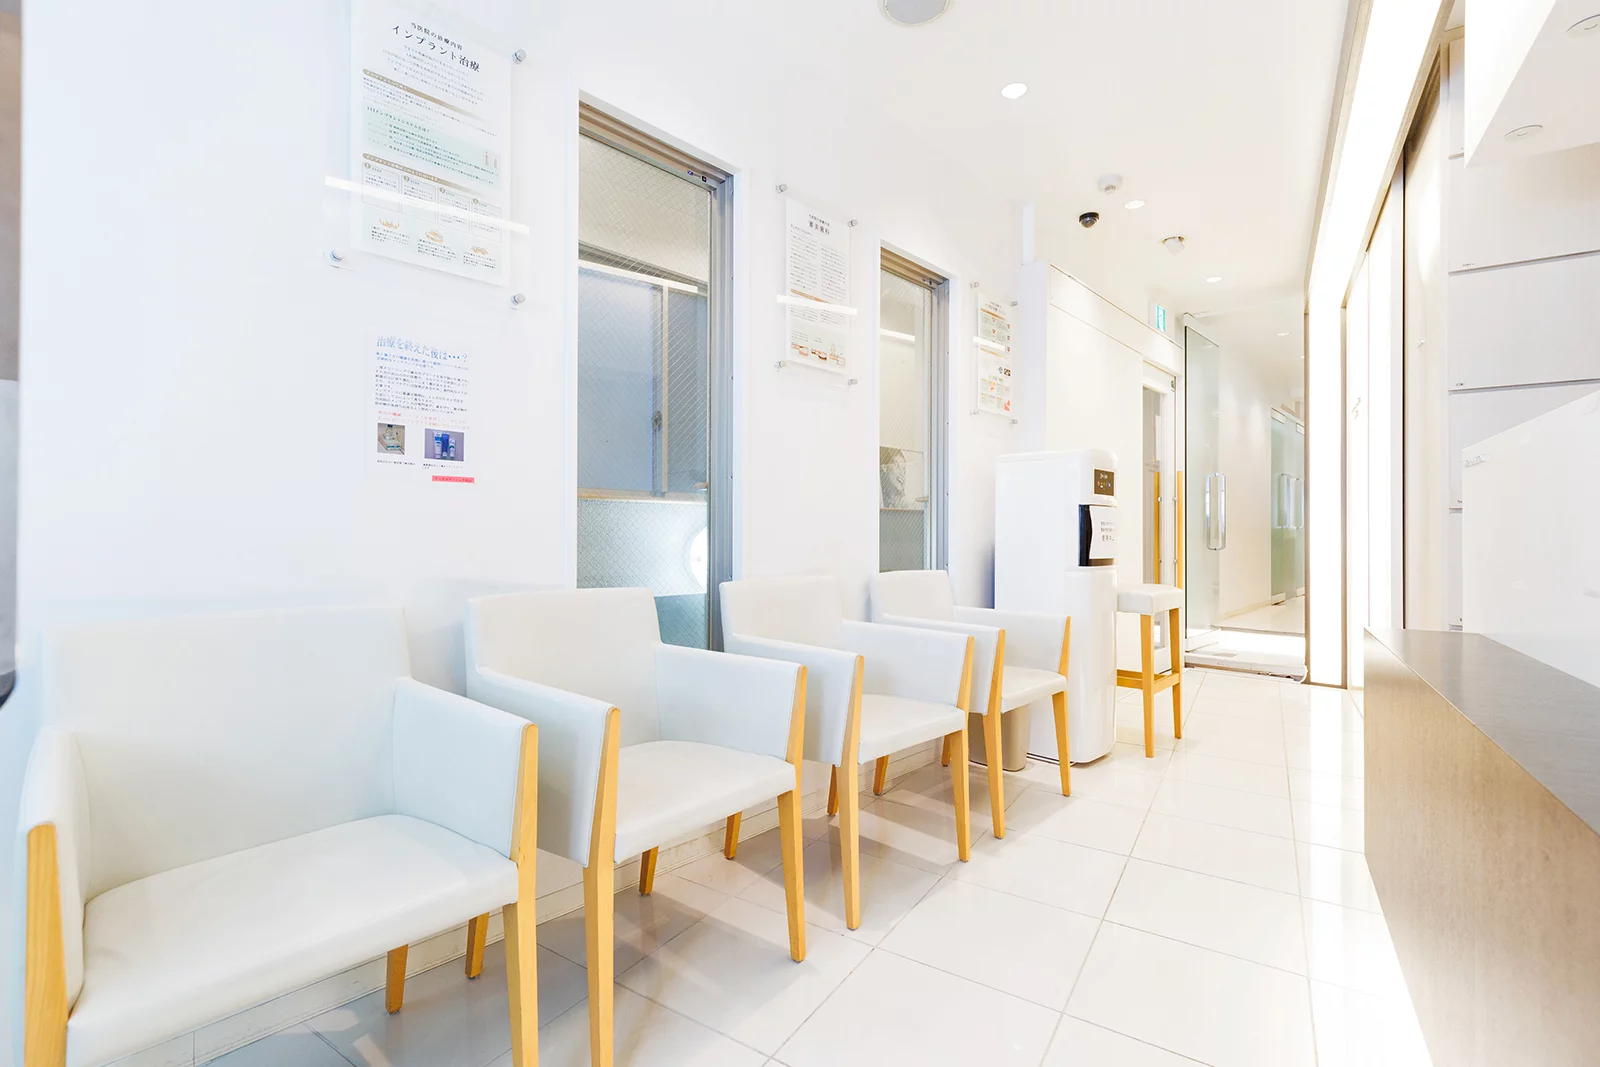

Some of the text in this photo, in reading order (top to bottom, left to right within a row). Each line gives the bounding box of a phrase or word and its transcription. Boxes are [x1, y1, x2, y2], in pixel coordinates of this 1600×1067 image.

[392, 25, 480, 72] インプラント治療
